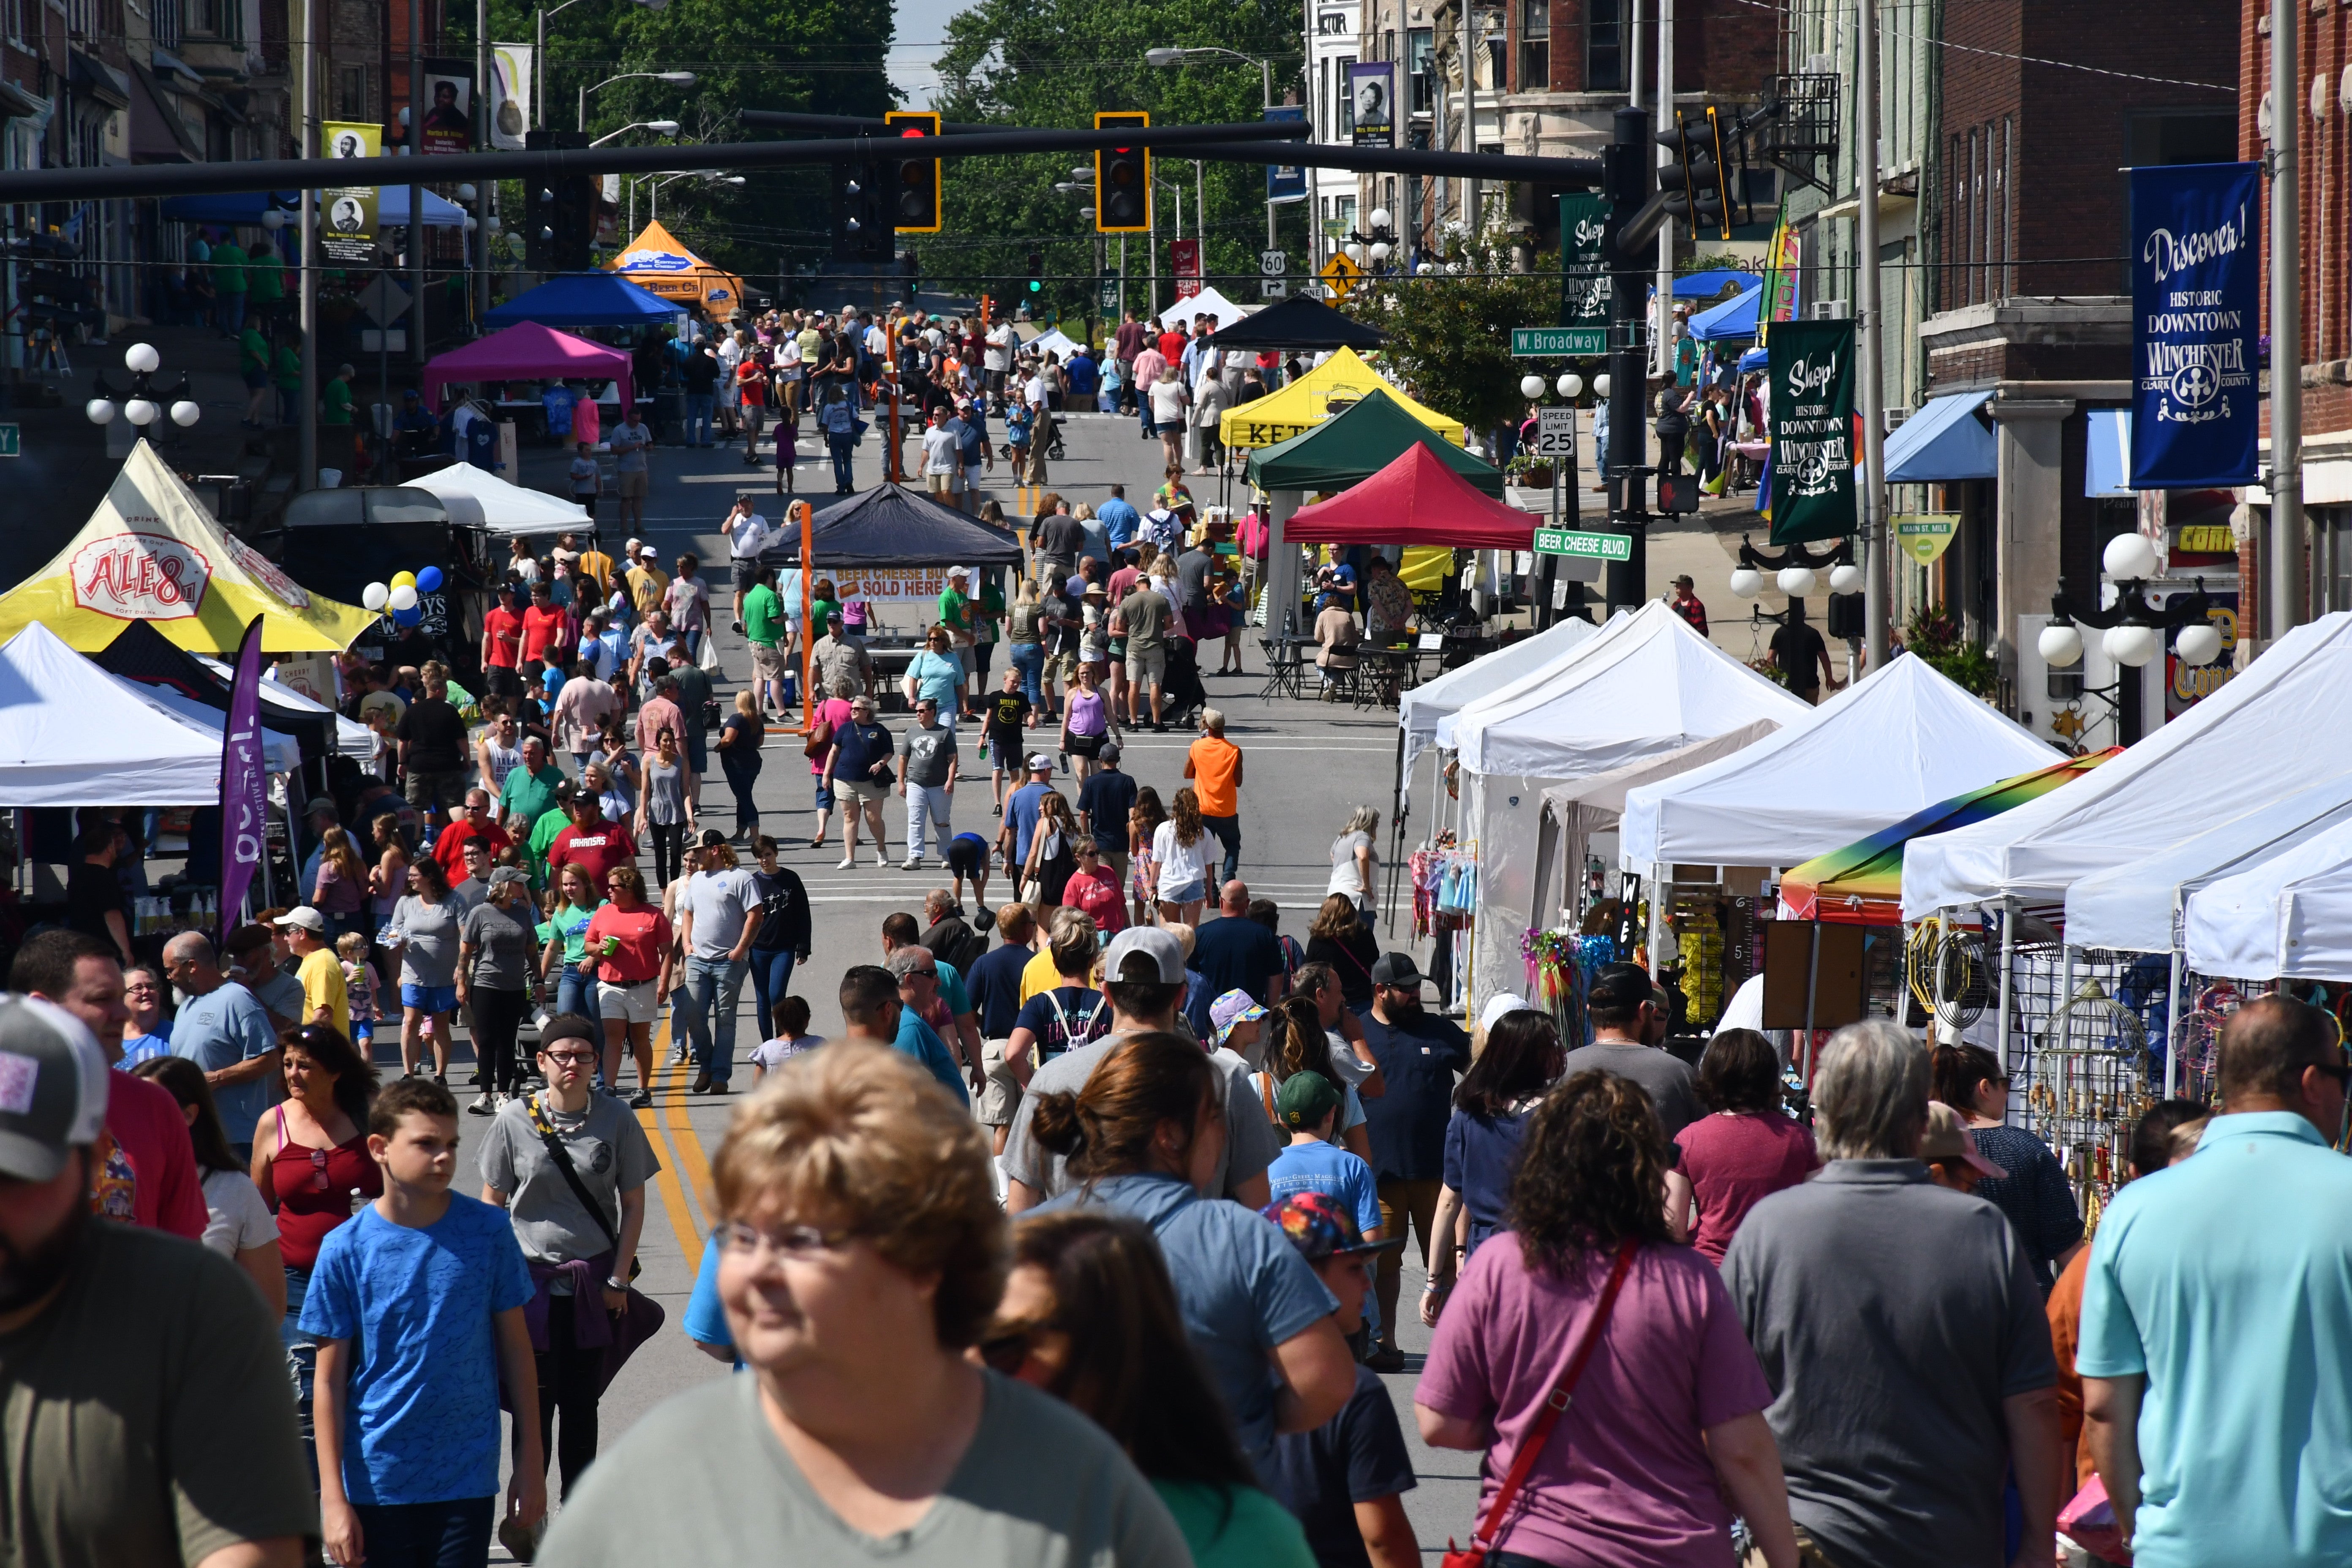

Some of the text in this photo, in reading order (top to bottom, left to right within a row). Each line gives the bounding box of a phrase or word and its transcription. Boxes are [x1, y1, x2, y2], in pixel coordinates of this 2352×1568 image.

[2144, 201, 2246, 284] Discover!
[1267, 256, 1282, 271] 60
[649, 282, 678, 292] BEER
[1304, 289, 1321, 297] ONE
[2170, 289, 2222, 308] HISTORIC
[2148, 310, 2241, 334] DOWNTOWN
[1517, 332, 1601, 354] W. Broadway
[2146, 338, 2245, 377] WINCHESTER
[1788, 350, 1837, 397] Shop!
[2141, 376, 2251, 393] CLARK COUNTY
[1542, 412, 1572, 421] SPEED
[1795, 404, 1829, 416] HISTORIC
[1545, 422, 1568, 431] LIMIT
[1780, 416, 1843, 435] DOWNTOWN
[1541, 433, 1571, 452] 25
[1779, 436, 1847, 465] WINCHESTER
[1776, 463, 1851, 475] CLARK COUNTY
[1902, 523, 1947, 534] MAIN ST. MILE
[1538, 533, 1626, 556] BEER CHEESE BLVD.
[1916, 543, 1933, 552] start!
[836, 568, 870, 582] BEER
[873, 568, 923, 580] CHEESE
[863, 579, 943, 596] SOLD HERE
[284, 668, 310, 678] CHERRY
[497, 757, 518, 765] TALK
[569, 836, 606, 849] ARKANSAS
[1736, 897, 1745, 908] 6
[1734, 945, 1742, 959] 5
[1078, 1008, 1092, 1020] dock
[1271, 1181, 1345, 1190] ORTHODONTIC
